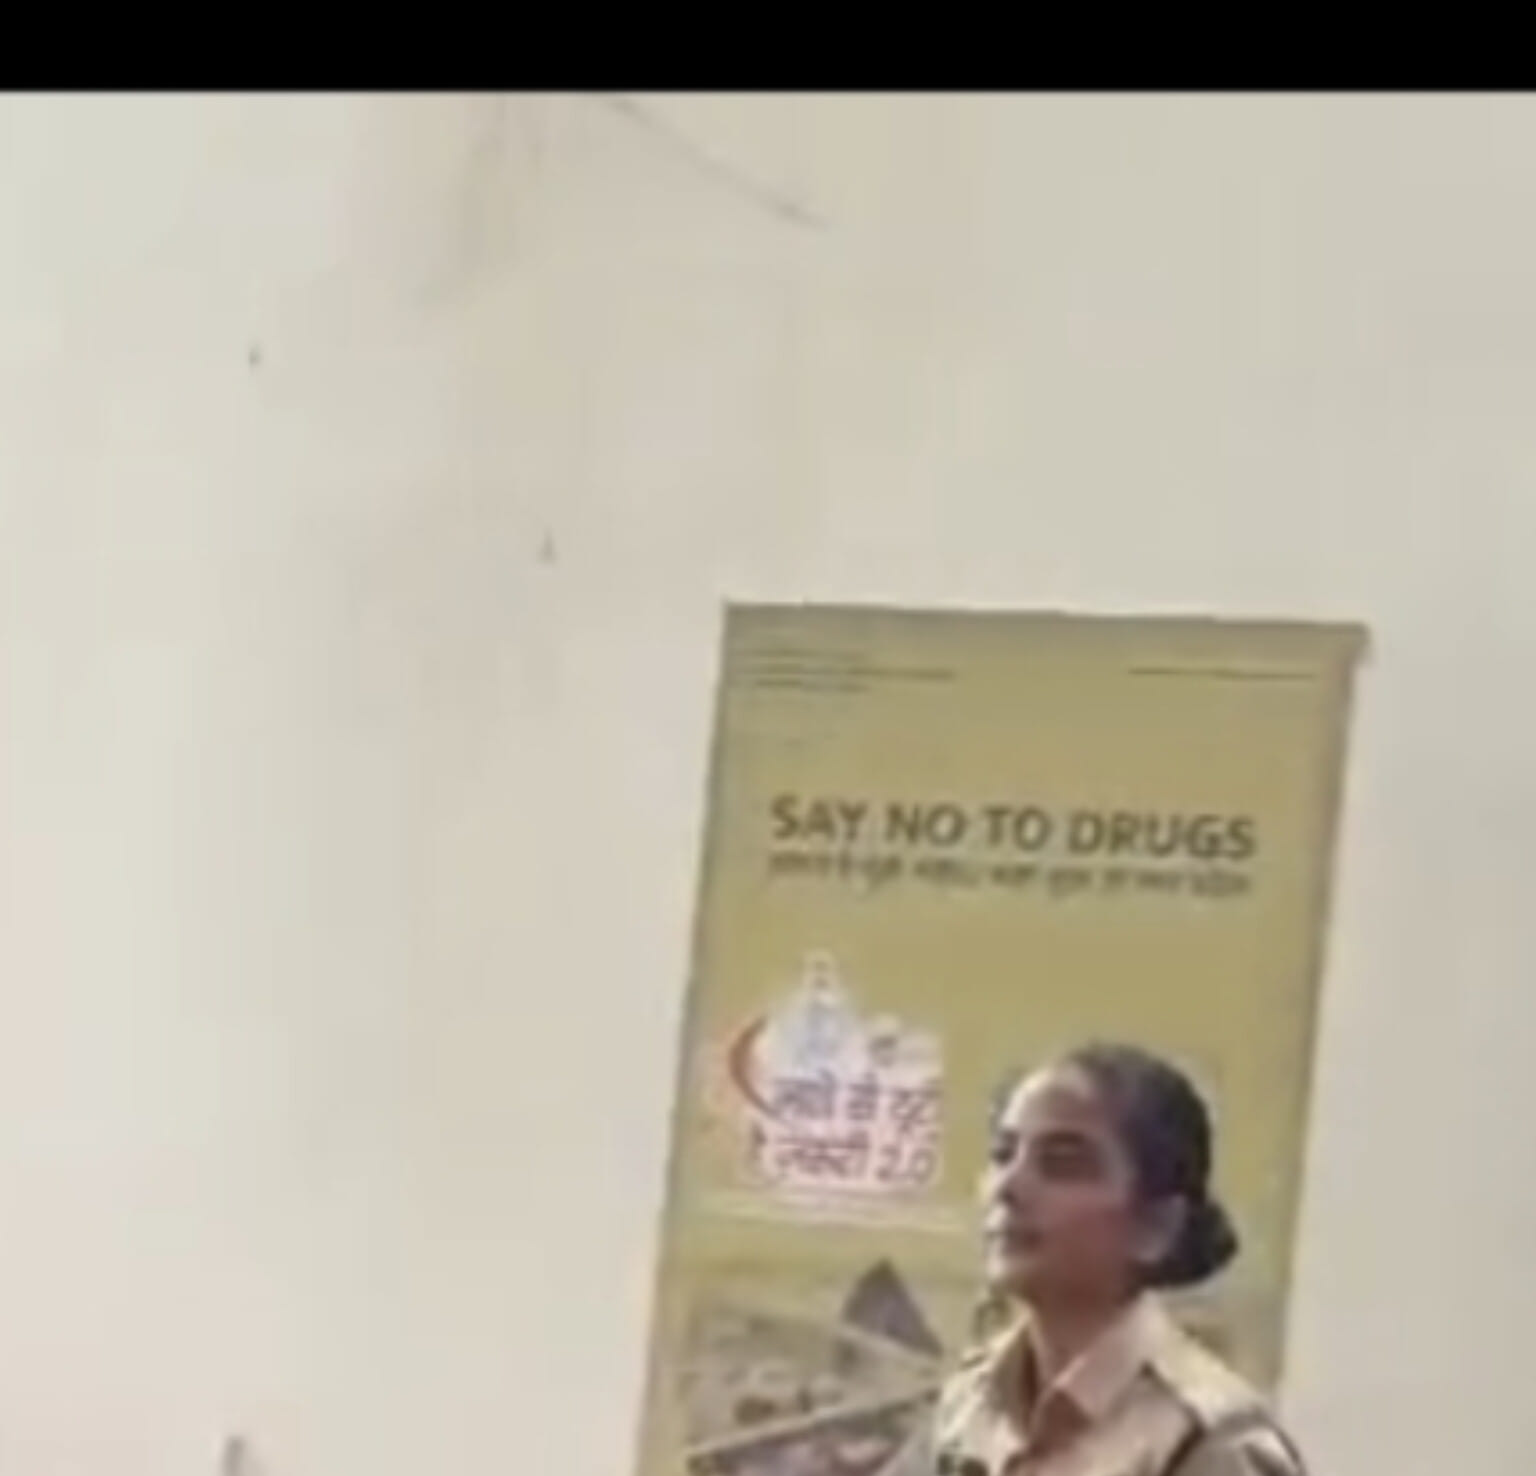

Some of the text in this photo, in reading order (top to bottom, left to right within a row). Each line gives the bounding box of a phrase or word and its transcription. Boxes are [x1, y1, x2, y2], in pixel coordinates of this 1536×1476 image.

[768, 793, 1257, 862] SAY NO TO DRUGS
